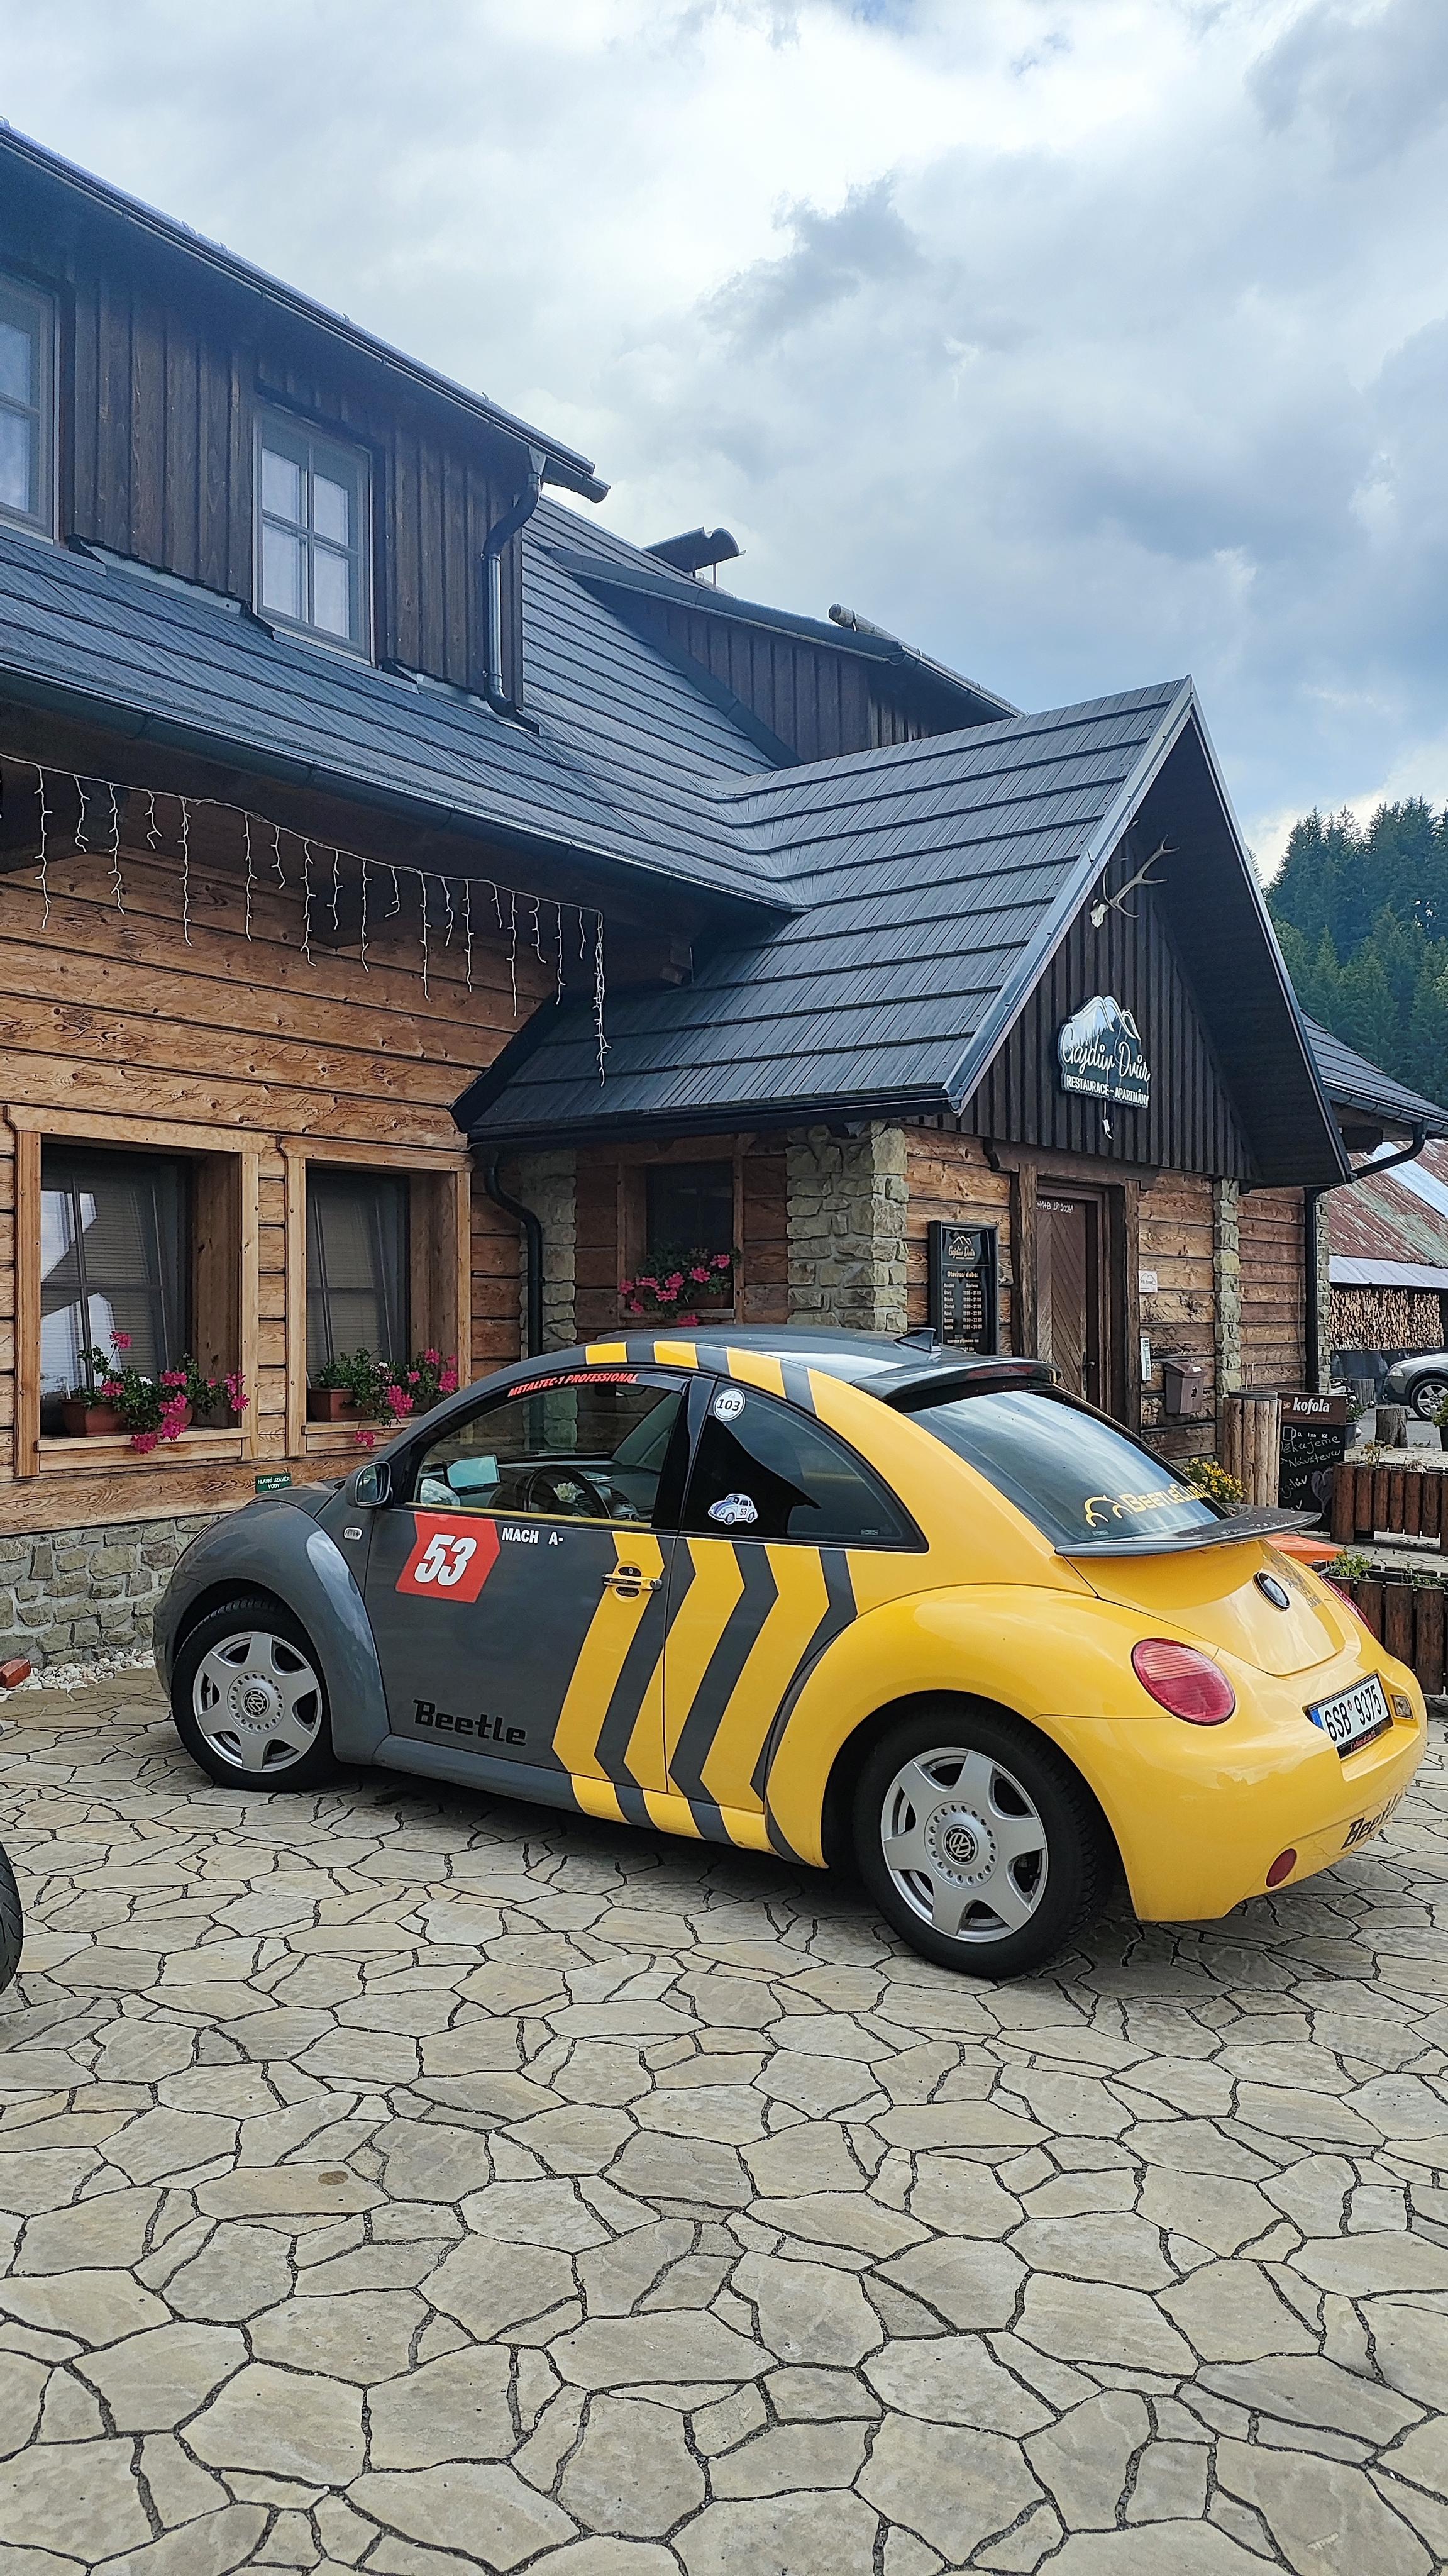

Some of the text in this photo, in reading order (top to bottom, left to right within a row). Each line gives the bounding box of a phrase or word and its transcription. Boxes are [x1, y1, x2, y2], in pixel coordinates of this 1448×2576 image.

[1119, 1041, 1151, 1082] Dvůr
[1066, 1075, 1109, 1096] RESTAURACE
[1115, 1087, 1149, 1106] APARTMÁNY
[507, 1372, 639, 1397] METALTEC-1 PROFESSIONAL
[717, 1399, 741, 1411] 103
[1292, 1397, 1330, 1415] kofola
[740, 1507, 748, 1516] 53
[502, 1527, 539, 1543] MACH
[414, 1533, 477, 1586] 53
[412, 1699, 526, 1746] Beetle
[1324, 1702, 1352, 1742] 6SB
[1354, 1684, 1382, 1726] 9375
